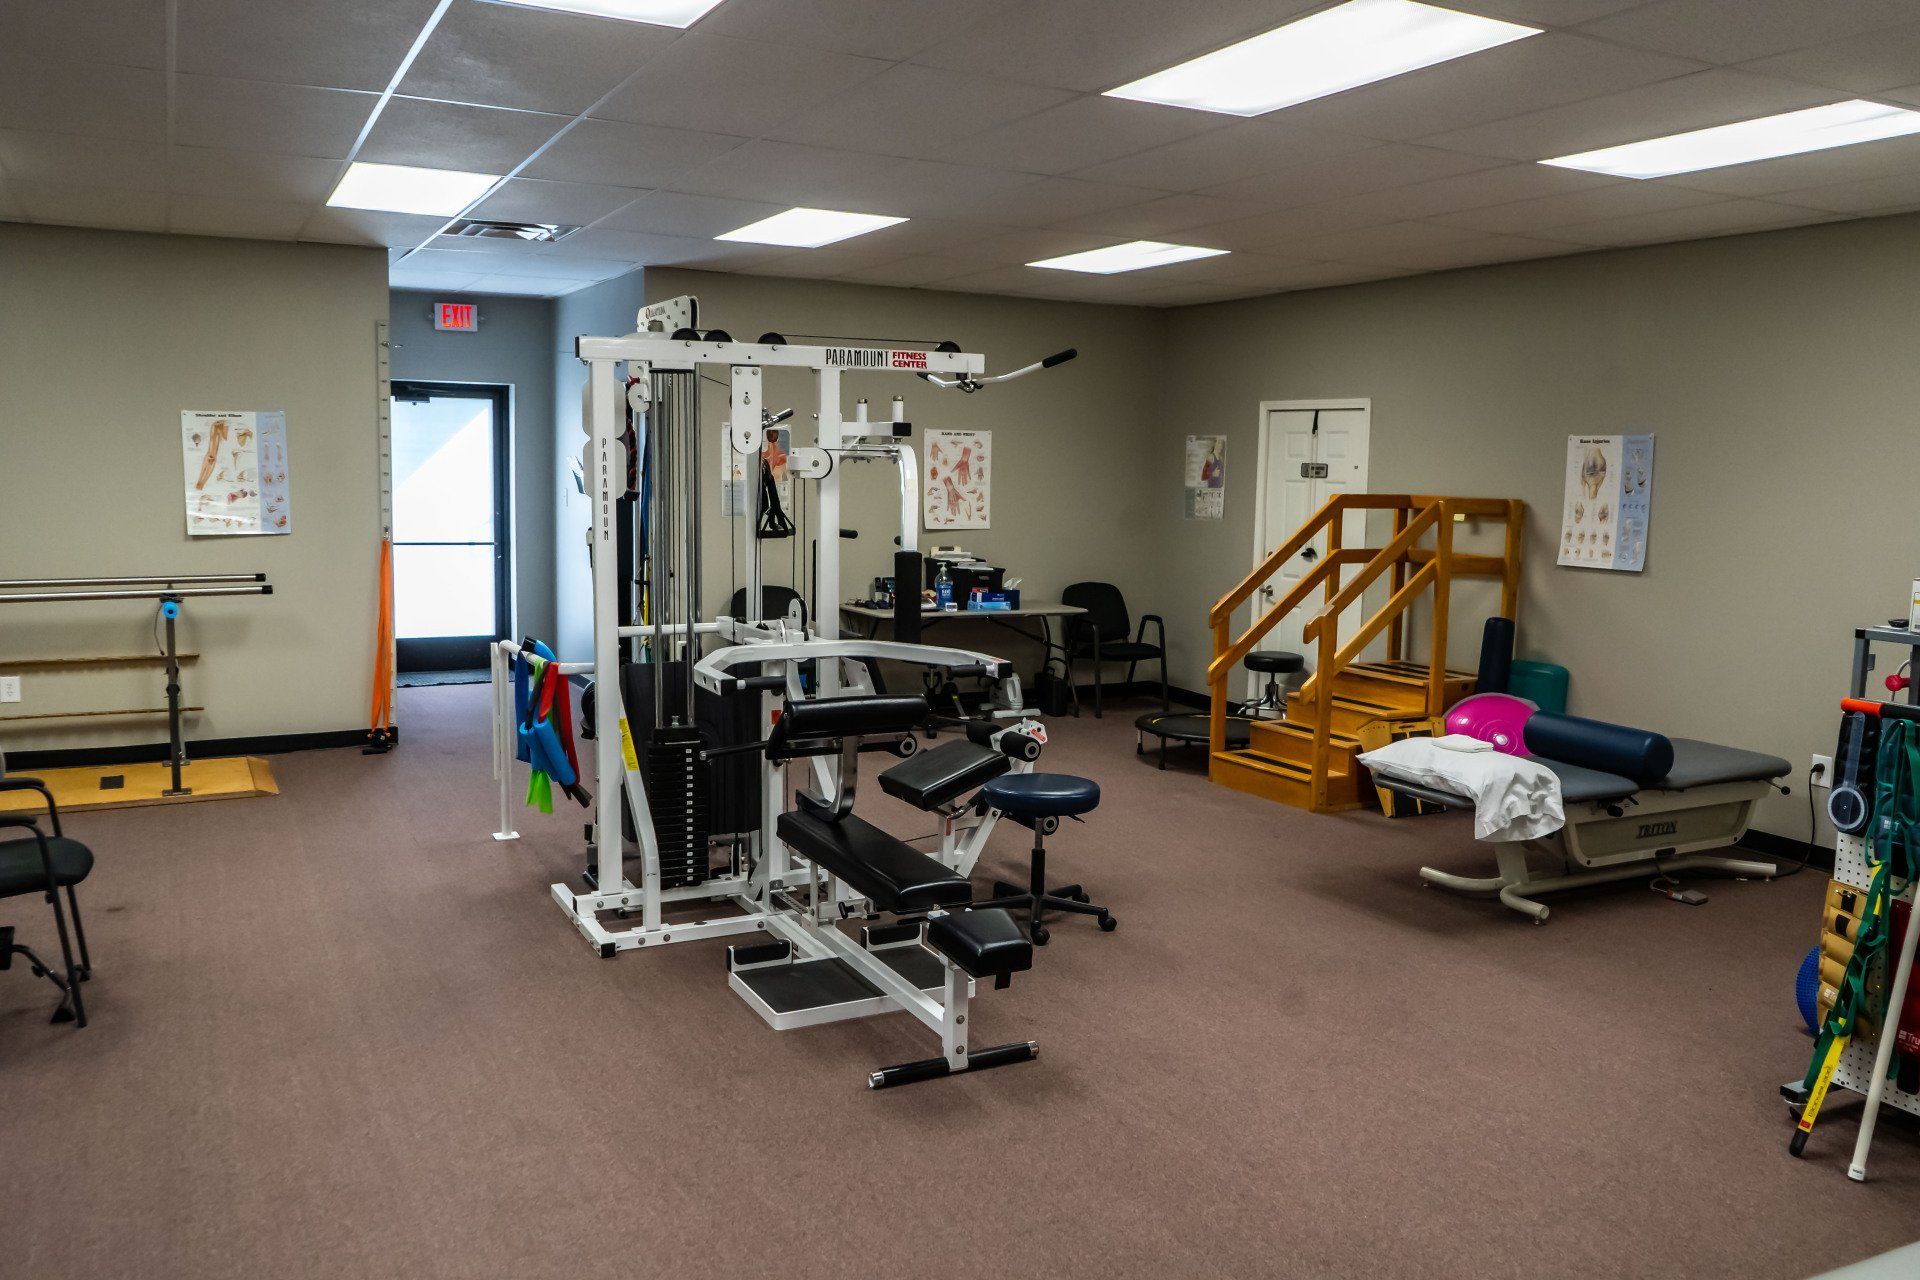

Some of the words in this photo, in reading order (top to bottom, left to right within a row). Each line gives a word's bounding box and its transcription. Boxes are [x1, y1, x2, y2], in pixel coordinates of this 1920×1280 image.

[441, 303, 472, 329] EXIT
[826, 348, 889, 368] PARAMOUNT
[892, 351, 927, 360] FITNESS
[892, 360, 928, 369] CENTER
[1636, 820, 1678, 839] TRITON
